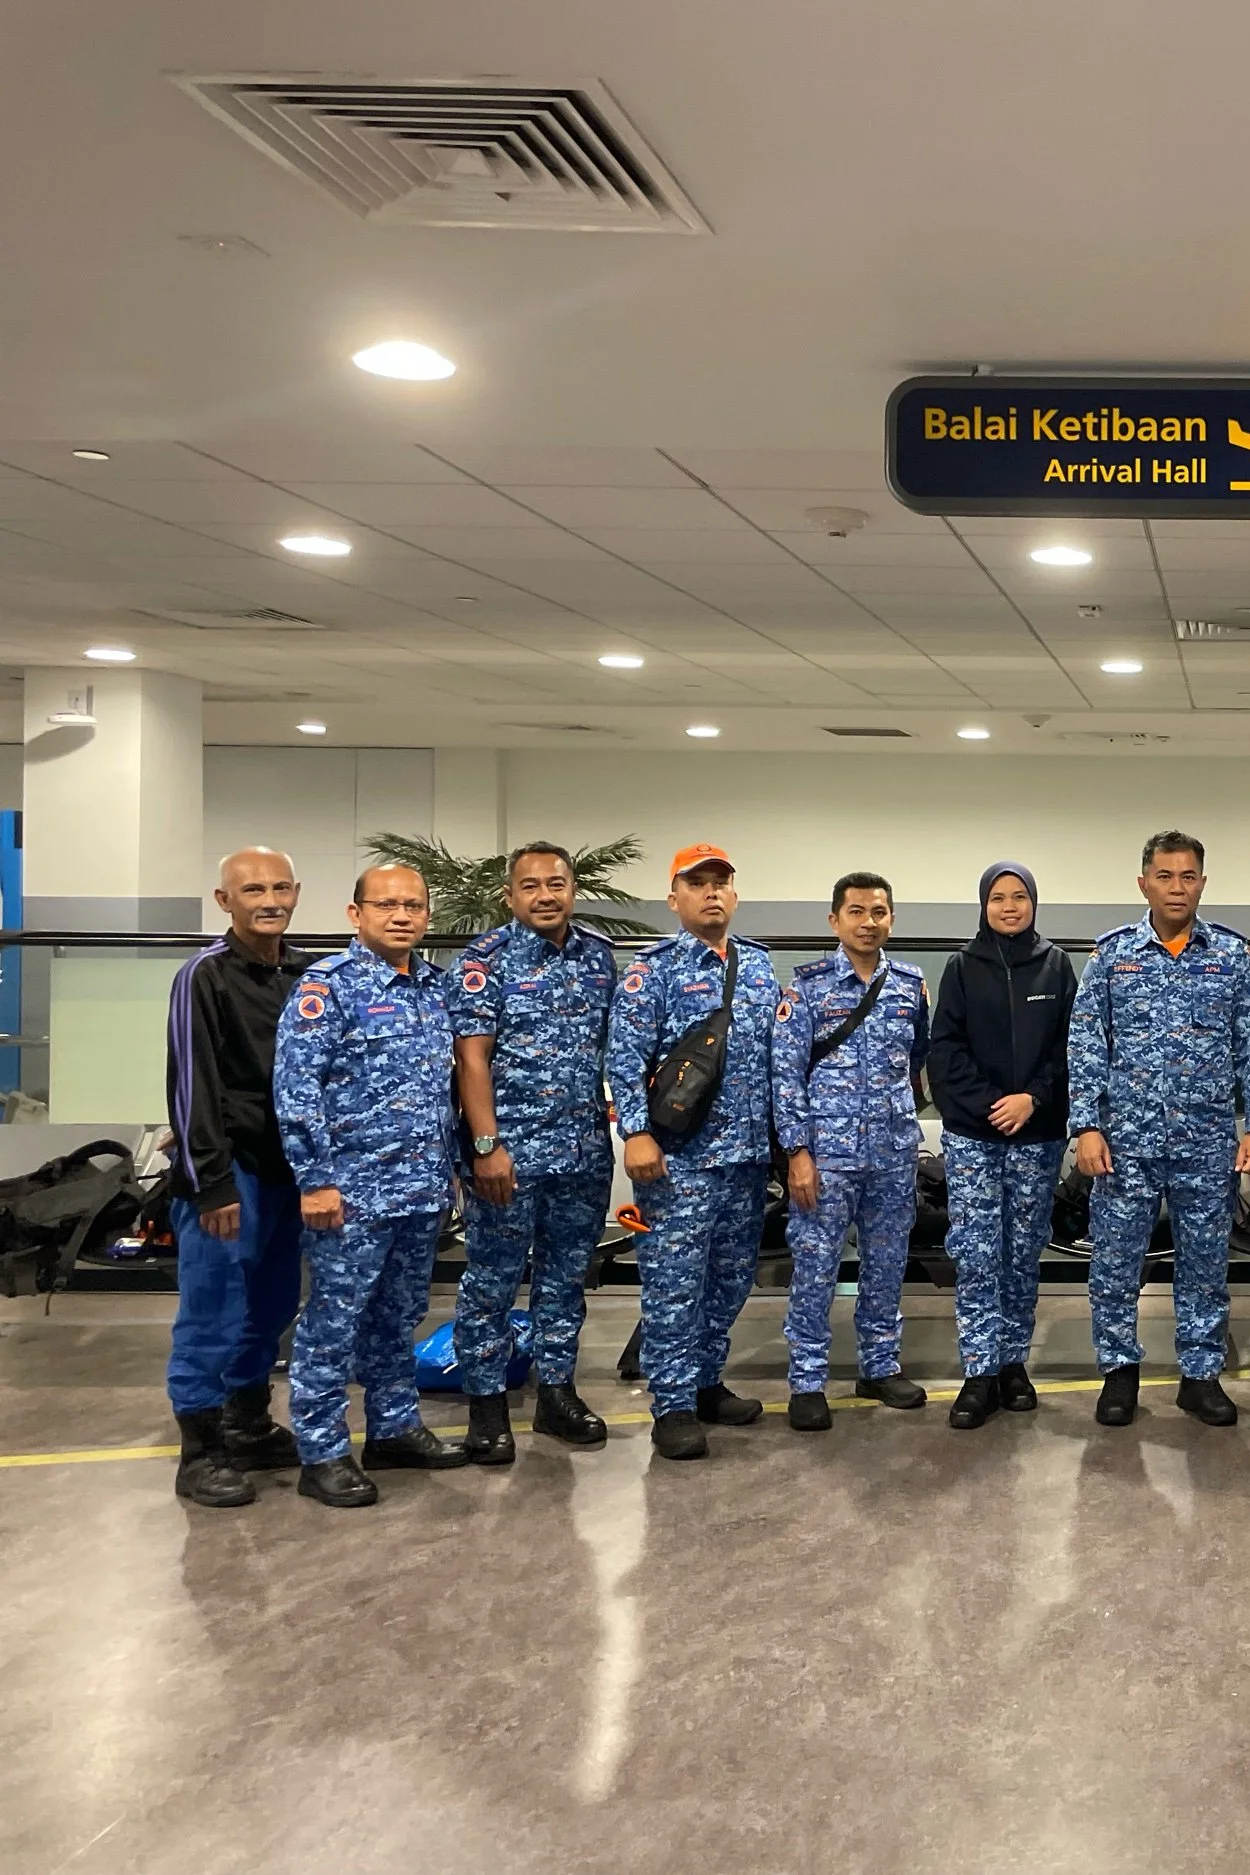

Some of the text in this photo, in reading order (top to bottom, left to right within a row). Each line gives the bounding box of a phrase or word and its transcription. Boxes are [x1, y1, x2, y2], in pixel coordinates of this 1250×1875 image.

[925, 406, 1208, 443] Balai Ketibaan
[1043, 457, 1208, 485] Arrival Hall
[1204, 966, 1221, 974] APM
